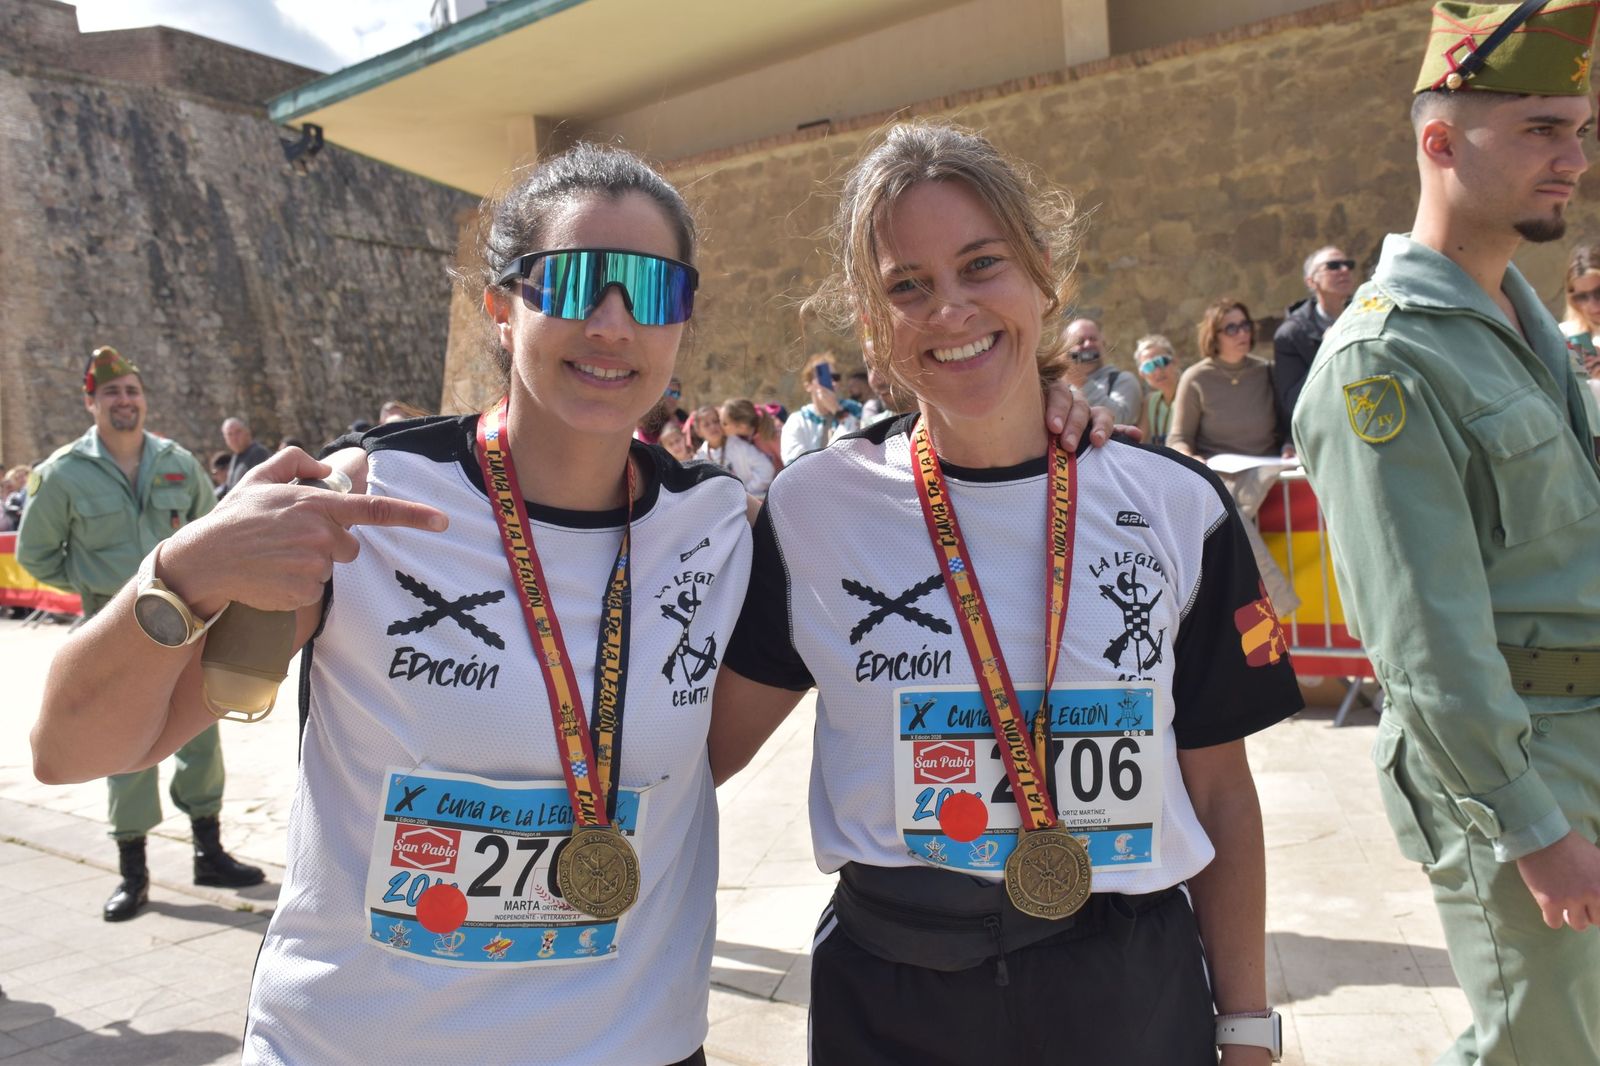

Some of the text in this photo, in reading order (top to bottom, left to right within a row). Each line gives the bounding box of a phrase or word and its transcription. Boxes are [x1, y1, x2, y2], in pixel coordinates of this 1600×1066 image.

[1377, 413, 1393, 426] IV
[1088, 557, 1110, 578] LA
[673, 571, 715, 586] LEGI
[908, 700, 936, 731] X
[914, 755, 975, 769] San Pablo
[394, 784, 428, 812] X
[537, 803, 576, 826] LEGI
[393, 838, 457, 858] San Pablo
[503, 900, 541, 911] MARTA
